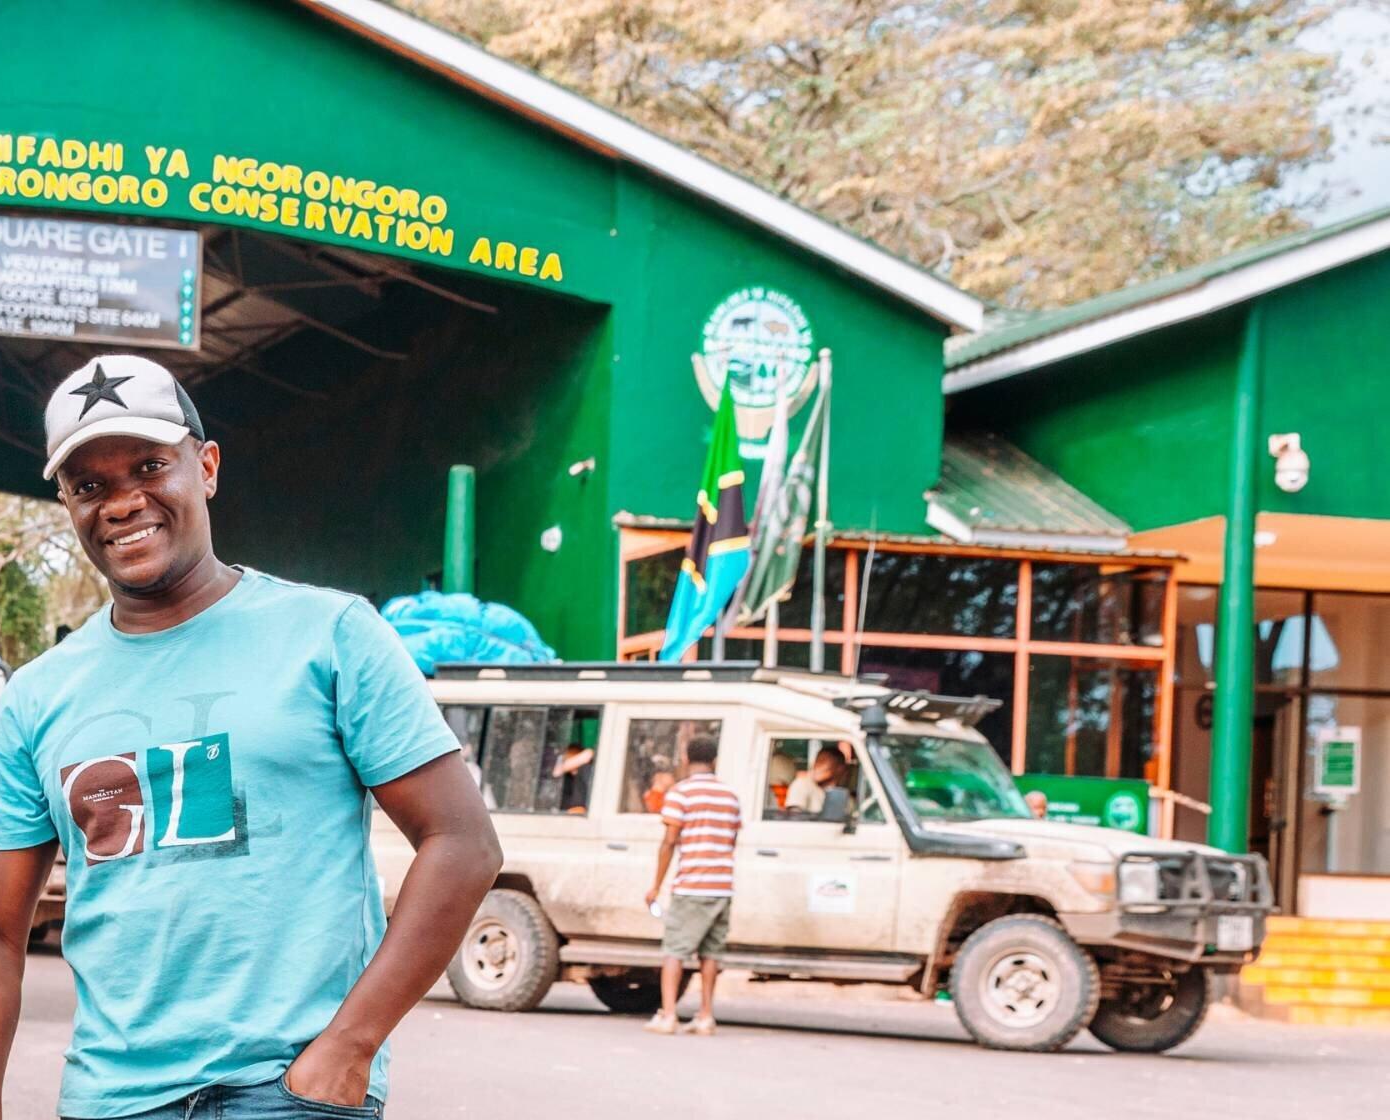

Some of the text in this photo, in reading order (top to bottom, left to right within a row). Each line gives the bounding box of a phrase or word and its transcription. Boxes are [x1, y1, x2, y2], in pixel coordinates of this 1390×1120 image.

[145, 146, 190, 179] YA
[212, 154, 448, 226] NGORONGORO
[88, 225, 168, 260] GATE
[189, 182, 454, 257] CONSERVATION
[468, 236, 565, 283] AREA
[82, 788, 123, 801] MANHATTAN
